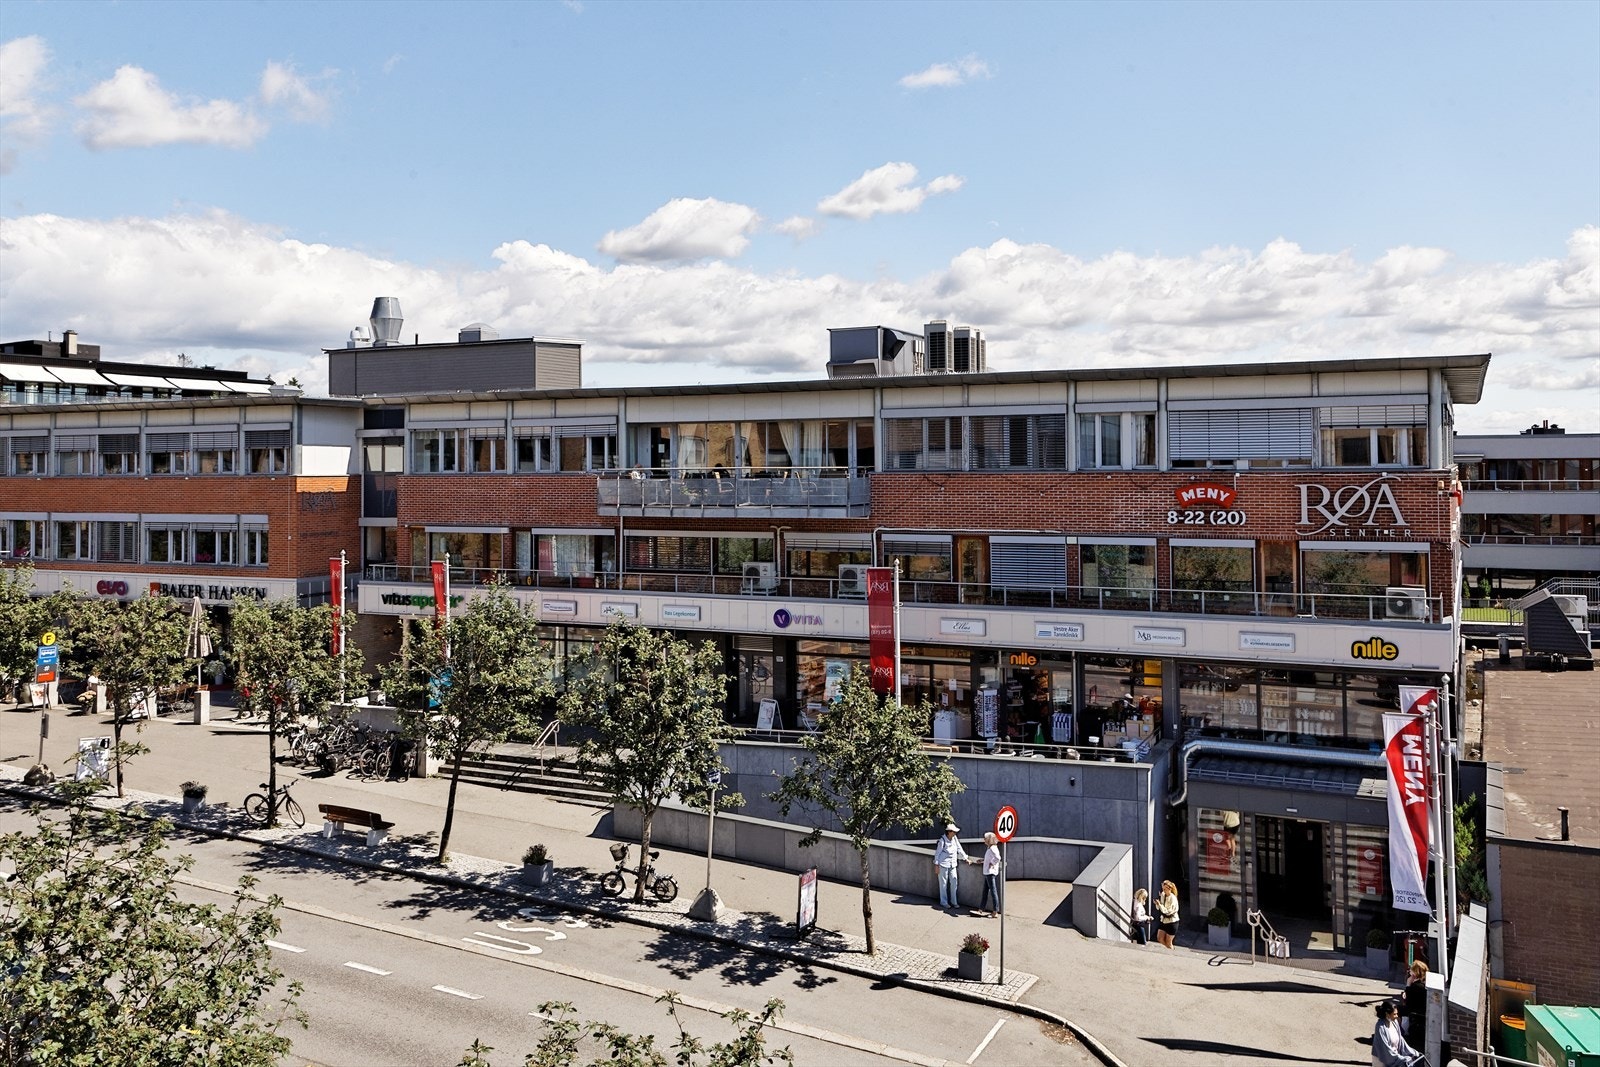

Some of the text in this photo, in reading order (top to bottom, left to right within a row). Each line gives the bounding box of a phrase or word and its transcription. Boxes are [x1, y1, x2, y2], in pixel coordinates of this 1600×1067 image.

[1181, 487, 1230, 502] MENY
[1294, 476, 1411, 536] RØA
[1167, 510, 1247, 525] 8-22 (20)
[1329, 528, 1412, 537] SENTER
[96, 579, 128, 596] evo
[162, 583, 204, 599] BAKER
[208, 585, 267, 601] HANSEN
[792, 615, 823, 625] VITA
[45, 634, 52, 644] F
[1352, 638, 1398, 660] nille
[1009, 652, 1038, 666] nille
[999, 815, 1013, 833] 40
